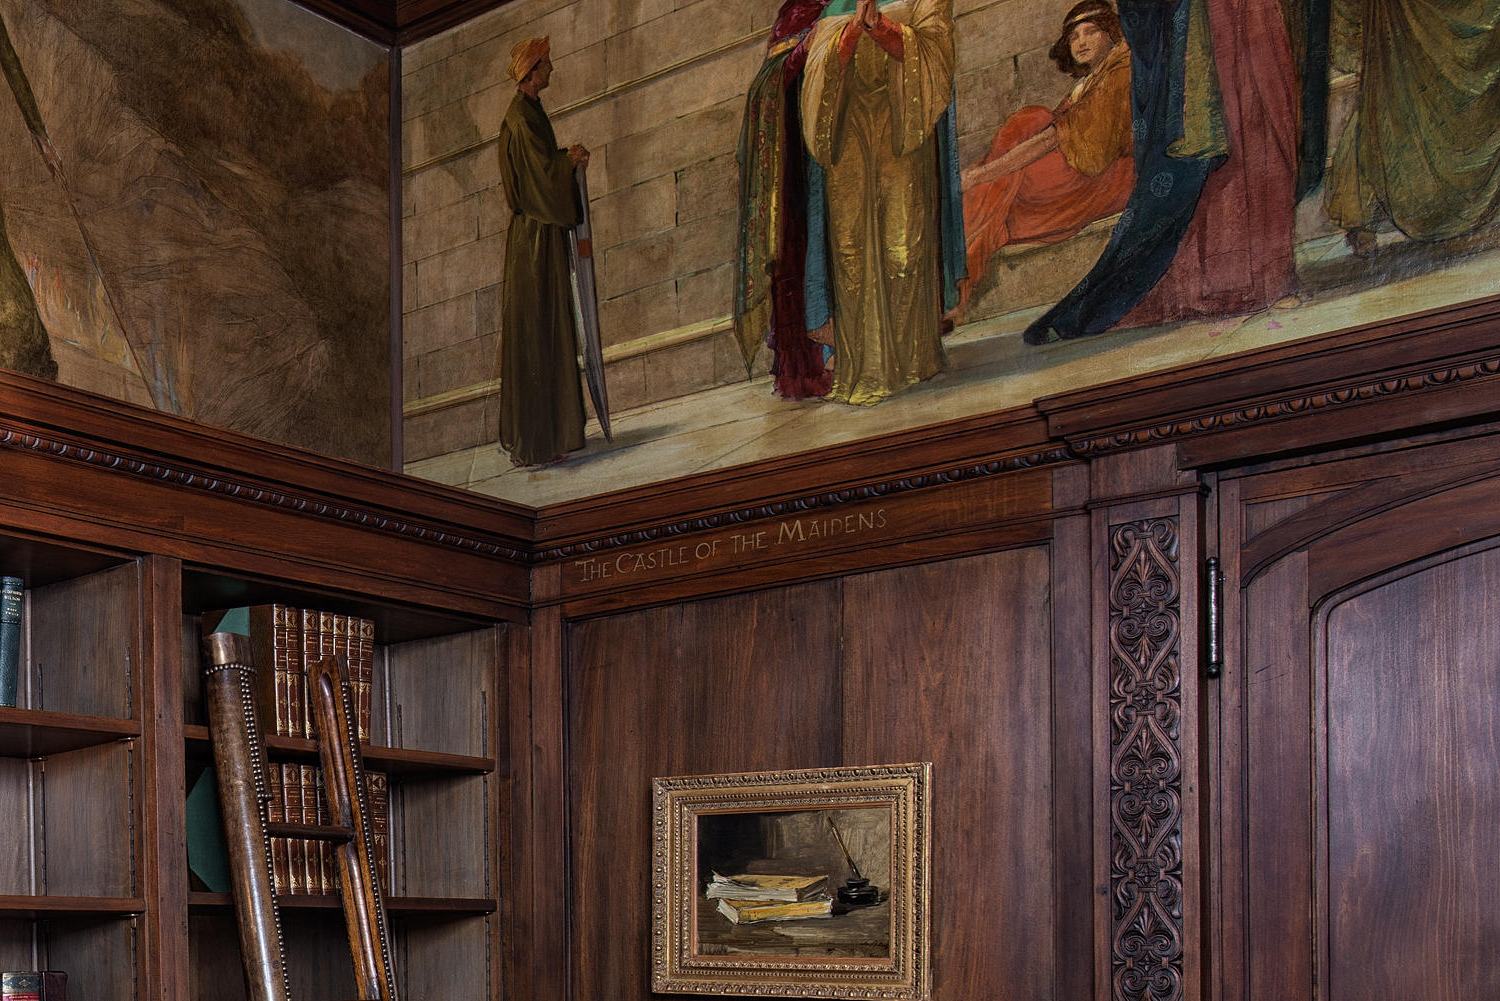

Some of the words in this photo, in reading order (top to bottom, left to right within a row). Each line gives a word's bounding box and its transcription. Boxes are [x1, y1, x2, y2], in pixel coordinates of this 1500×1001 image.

[575, 558, 612, 582] THE
[615, 546, 689, 574] CASTLE
[695, 539, 722, 560] OF
[730, 532, 769, 555] THE
[775, 509, 887, 545] MAIDENS
